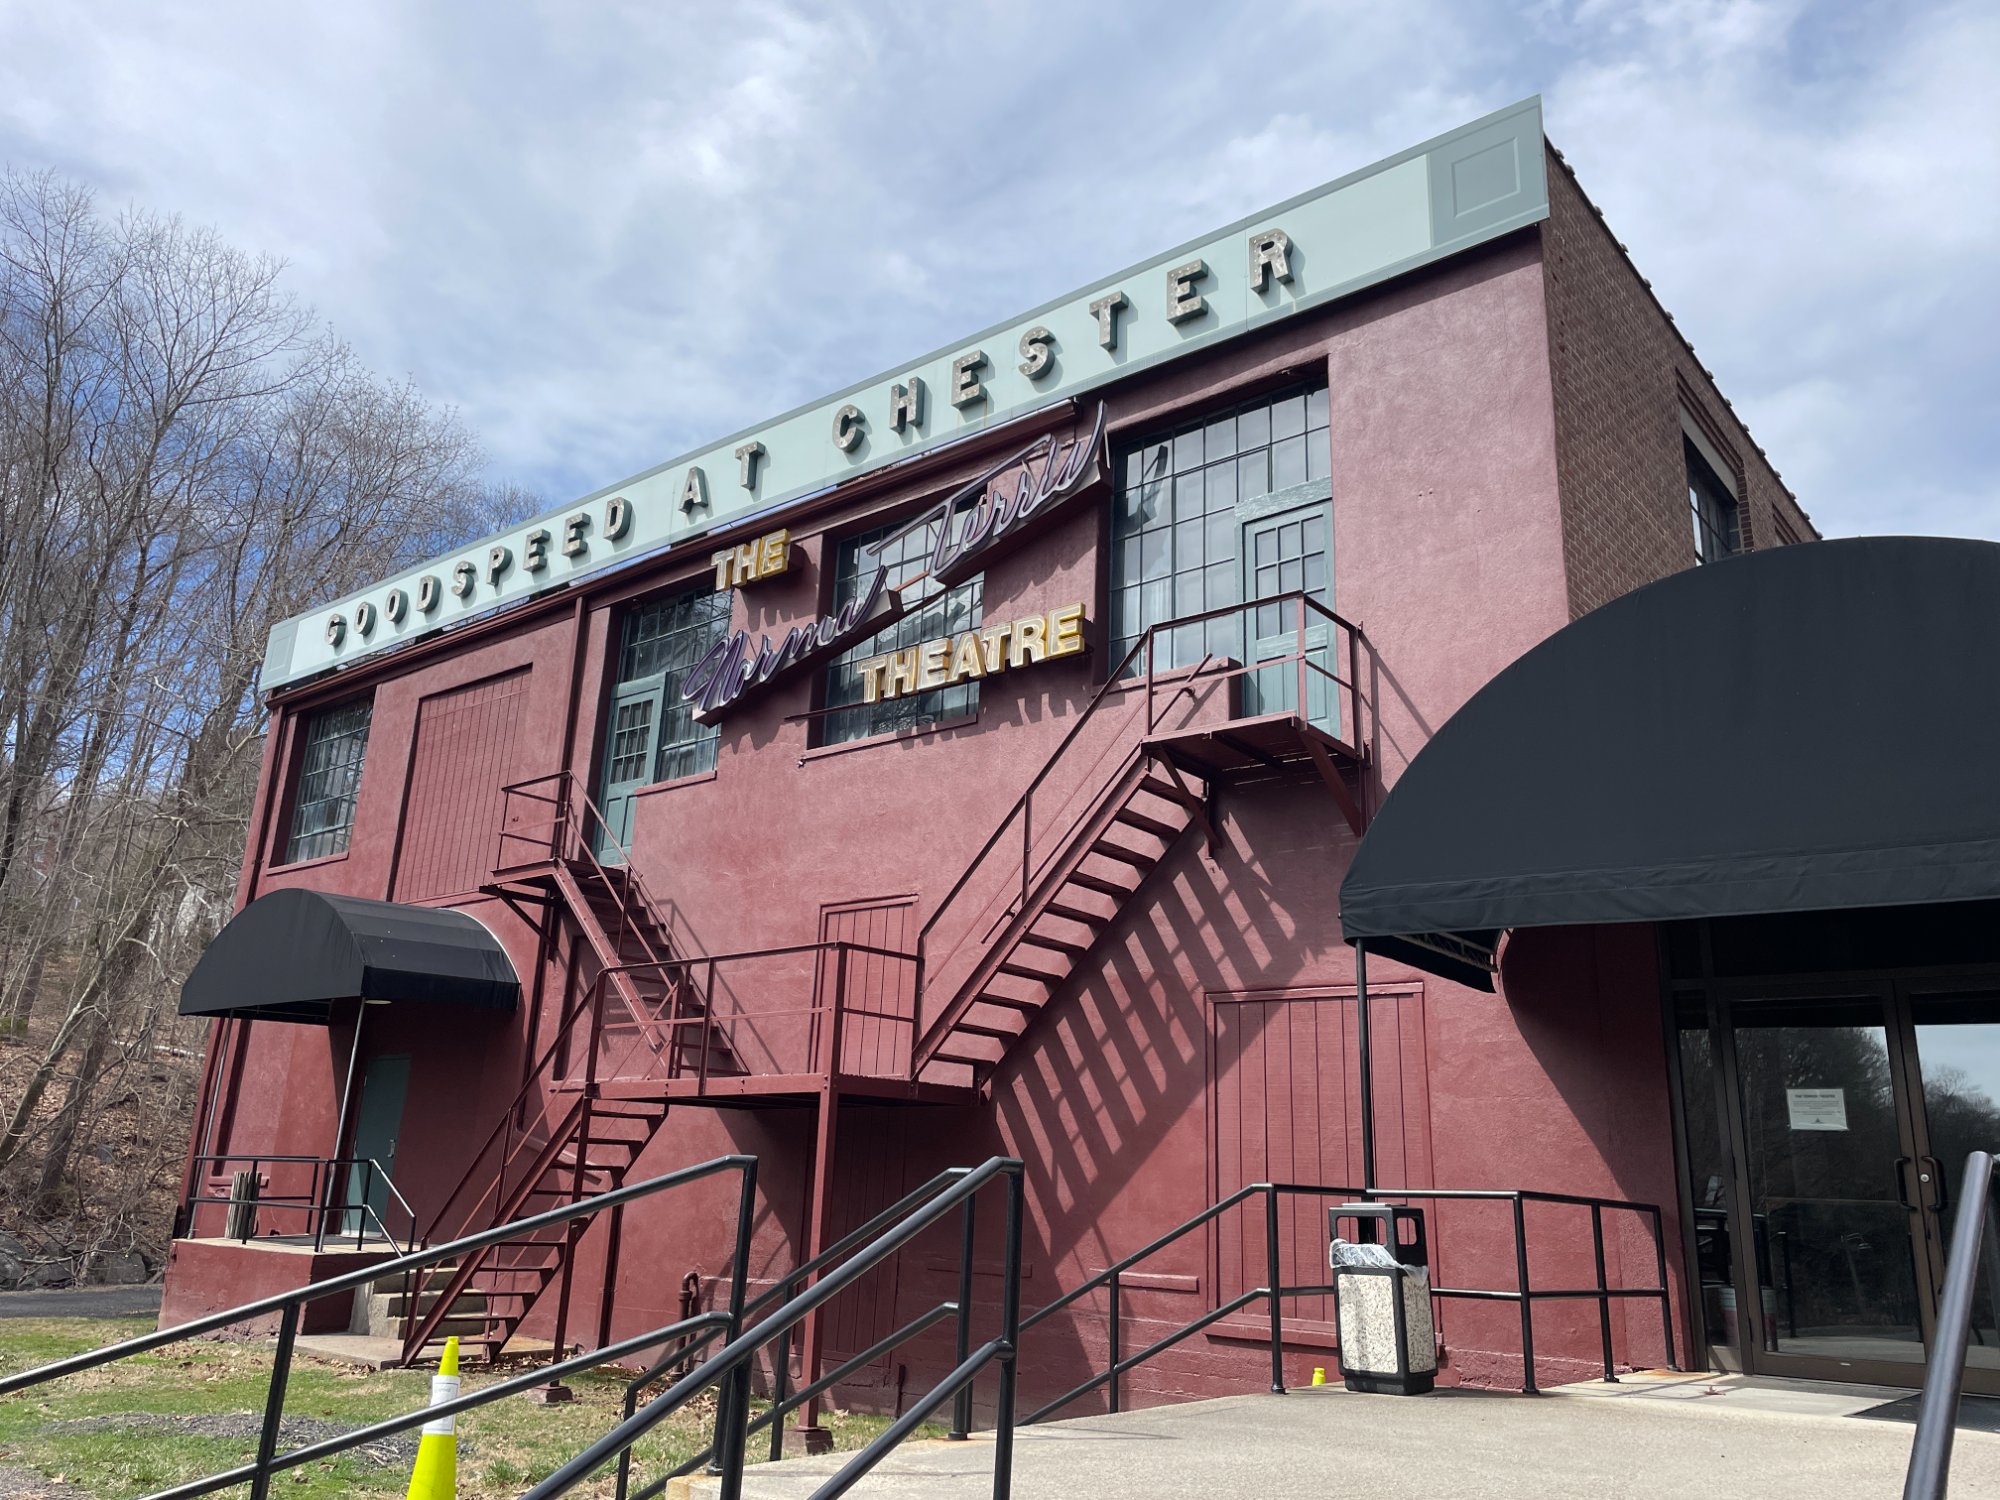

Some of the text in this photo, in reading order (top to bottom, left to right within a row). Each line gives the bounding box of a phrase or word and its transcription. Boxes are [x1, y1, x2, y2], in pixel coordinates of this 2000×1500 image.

[325, 227, 1295, 648] GOODSPEED AT CHESTER
[711, 528, 790, 592] THE
[681, 564, 890, 713] Norma
[856, 601, 1086, 704] THEATRE
